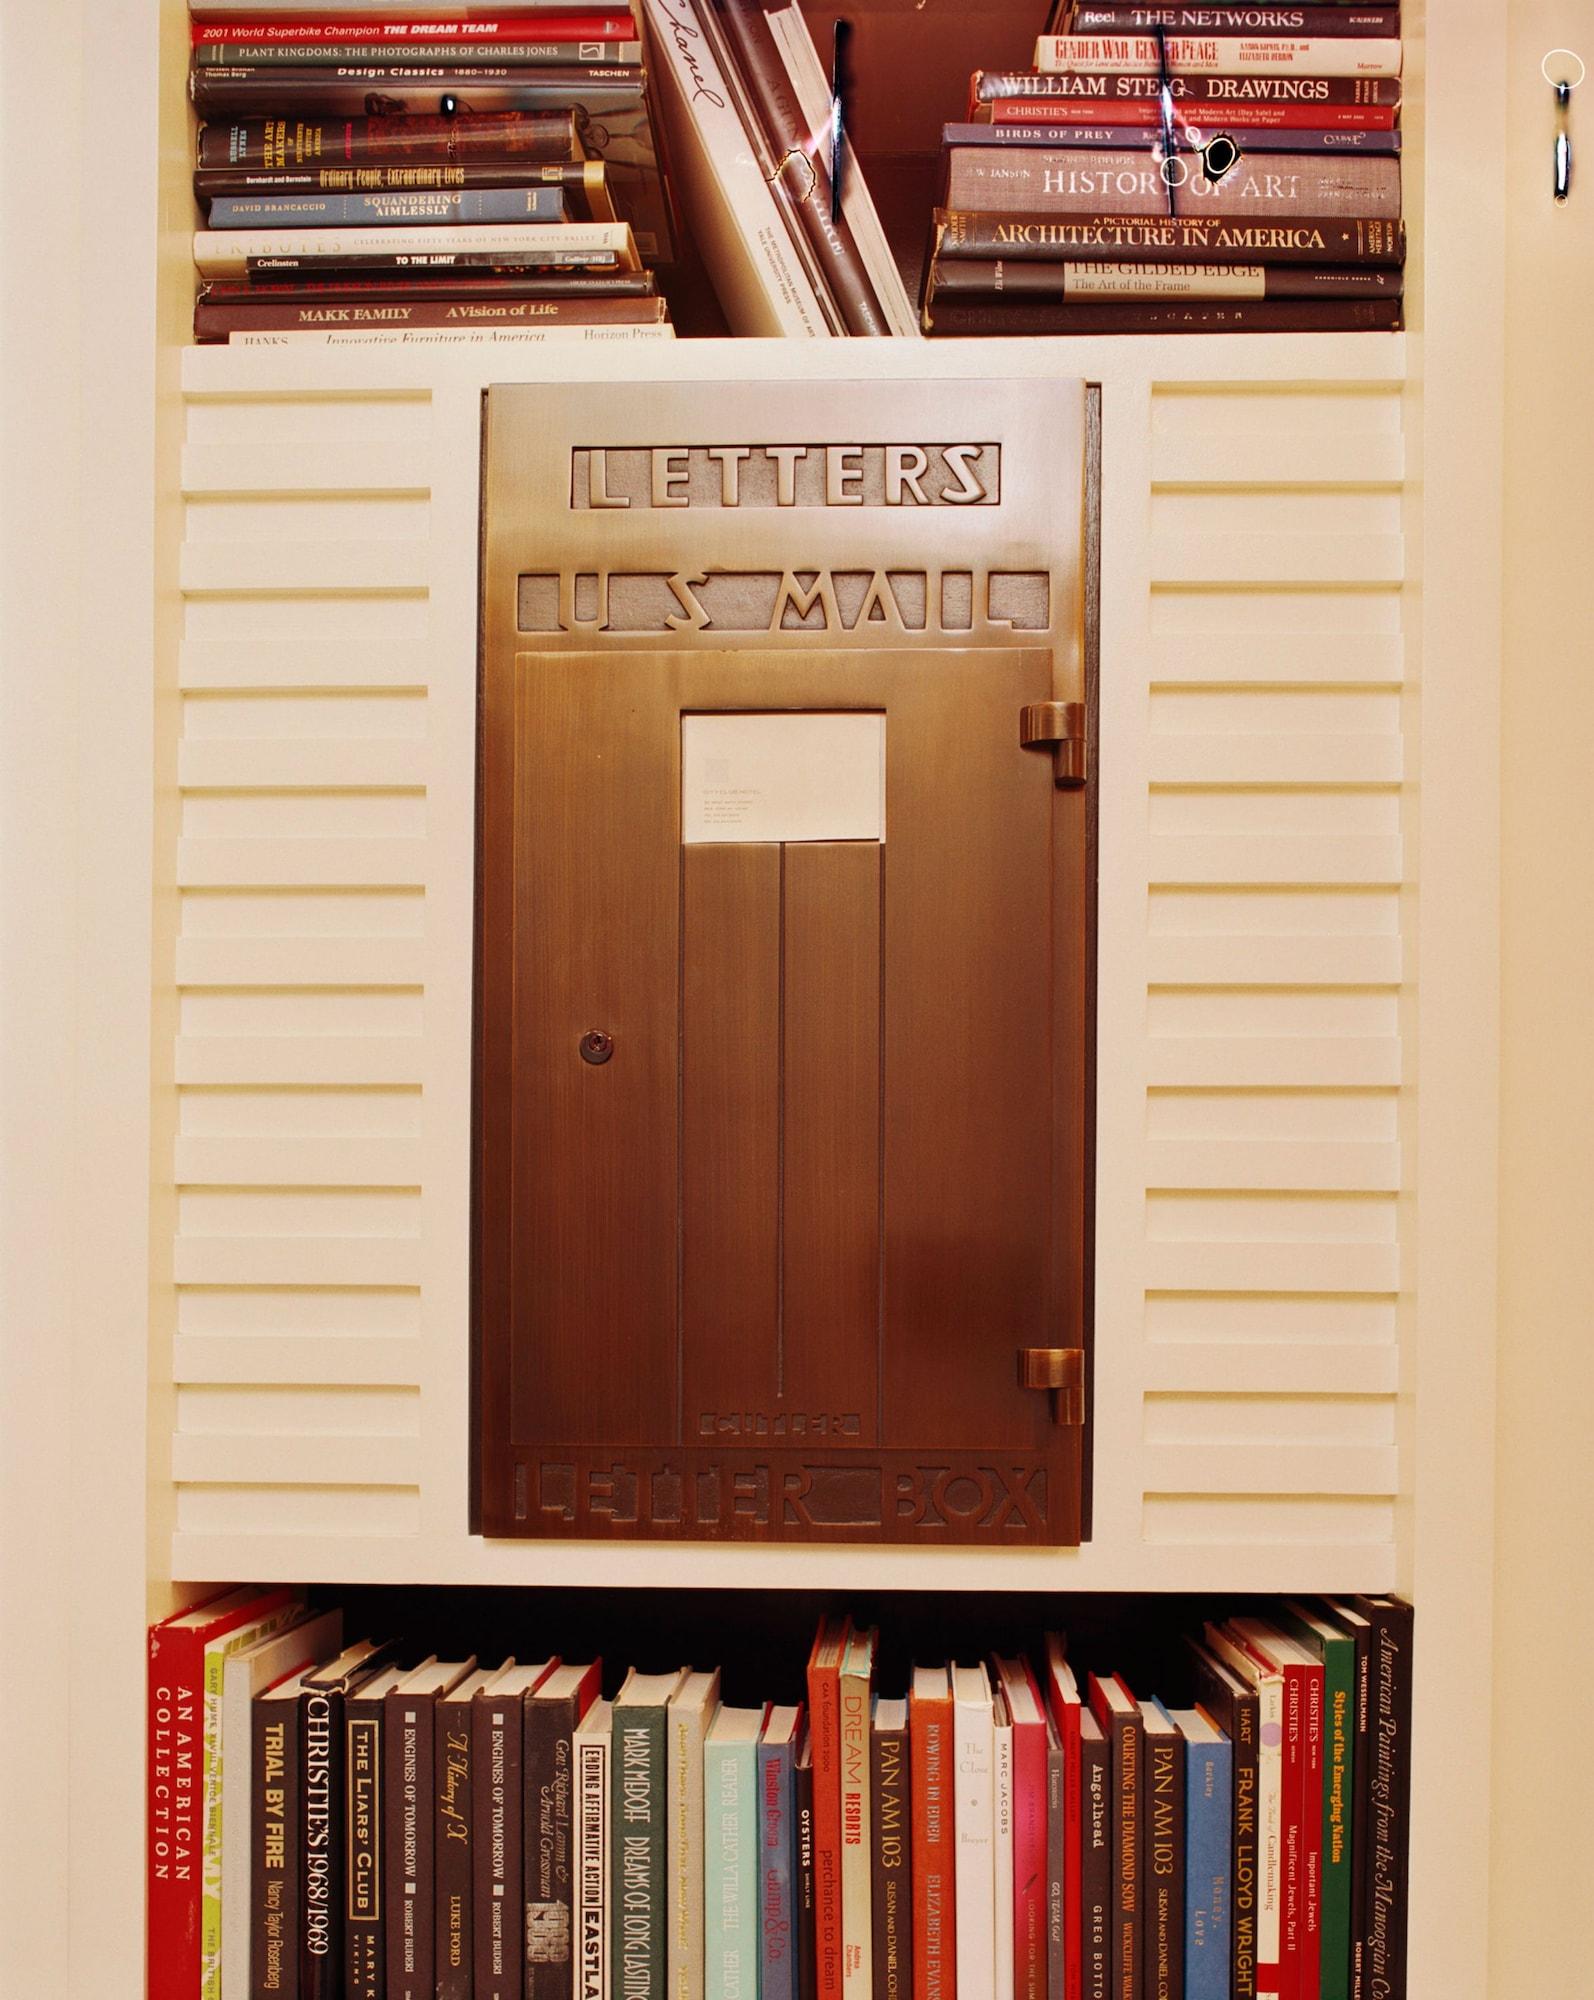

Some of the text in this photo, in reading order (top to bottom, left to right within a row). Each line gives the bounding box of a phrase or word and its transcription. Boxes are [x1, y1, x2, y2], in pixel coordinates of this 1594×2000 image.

[203, 24, 498, 38] 2001 World Superbike Champion THE DREAM TEAM
[1085, 10, 1304, 27] Reel THE NETWORKS
[239, 46, 558, 57] PLANT KINGDOMS: THE PHOTOGRAPHS OF CHARLES JONES
[337, 68, 385, 77] Design
[390, 67, 444, 77] Classics
[1055, 40, 1099, 59] GENDER
[1102, 40, 1129, 59] WAR
[1001, 77, 1329, 99] WILLIAM STEG DRAWINGS
[1007, 107, 1067, 116] CHRISTIE'S
[995, 130, 1113, 139] BIRDS OF PREY
[990, 169, 1031, 179] JANSON
[1240, 175, 1300, 198] ART
[232, 203, 326, 213] DAVID BRANCACCIO
[364, 194, 462, 207] SQUANDERING
[376, 206, 448, 217] AIMLESSLY
[1093, 217, 1100, 225] A
[1104, 218, 1156, 226] PICTORIAL
[1159, 218, 1203, 227] HISTORY
[992, 224, 1326, 249] ARCHITECTURE IN AMERICA
[257, 256, 455, 267] Crelinsten TO THE LIMIT
[1073, 279, 1190, 292] The Art of the Frame
[1118, 263, 1197, 276] GILDED
[1204, 265, 1259, 278] EDGE
[299, 308, 412, 322] MAKK FAMILY
[446, 304, 559, 318] A Vision of Life
[587, 443, 988, 509] LETTERS
[559, 570, 1015, 631] U S MAIL
[524, 1461, 1048, 1528] LETTER BOX
[1360, 1655, 1368, 1673] TOM
[1289, 1679, 1299, 1742] CHRISTIE'S
[1309, 1679, 1319, 1742] CHRISTIE'S
[357, 1732, 368, 1770] THE
[845, 1696, 861, 1844] DREAM RESORTS
[156, 1687, 170, 1879] COLLECTION
[175, 1686, 192, 1881] AN AMERICAN
[722, 1758, 737, 1806] READER
[1000, 1743, 1008, 1835] MARC JACOBS
[1330, 1691, 1345, 1863] Styles of the Emerging Nation
[1368, 1627, 1399, 1975] American Paintings from the Manoogian
[307, 1697, 329, 1955] CHRISTIE'S 1968/1969
[584, 1750, 600, 1903] ENDING AFFIRMATIVE ACTION
[880, 1740, 901, 1868] PAN AM 103
[1091, 1764, 1104, 1848] Angelhead
[1121, 1726, 1135, 1912] COURTING THE DIAMOND SOW
[1153, 1748, 1173, 1874] PAN AM 103
[264, 1723, 284, 1989] TRIAL BY FIRE Nancy Taylor Rosenberg
[404, 1729, 416, 1972] ENGINES OF TOMORROW ROBERT BUDERI
[623, 1728, 650, 1950] MARK MEDOFF DREAMS OF LONG
[722, 1813, 738, 1861] CATHER
[801, 1810, 810, 1866] OYSTERS
[927, 1724, 941, 1955] ROWING IN EDEN ELIZABETH
[1237, 1708, 1254, 1997] HART FRANK LLOYD WRIGHT
[1286, 1825, 1297, 1881] Magnificent
[356, 1853, 372, 1909] CLUB
[722, 1863, 739, 1901] WILLA
[1306, 1851, 1318, 1932] Important Jewels
[449, 1896, 461, 1966] LUKE FORD
[722, 1903, 739, 1929] THE
[821, 1851, 837, 1991] perchance to dream
[1093, 1905, 1102, 1943] GREG
[1287, 1921, 1297, 1940] Part
[366, 1935, 375, 1981] MARY
